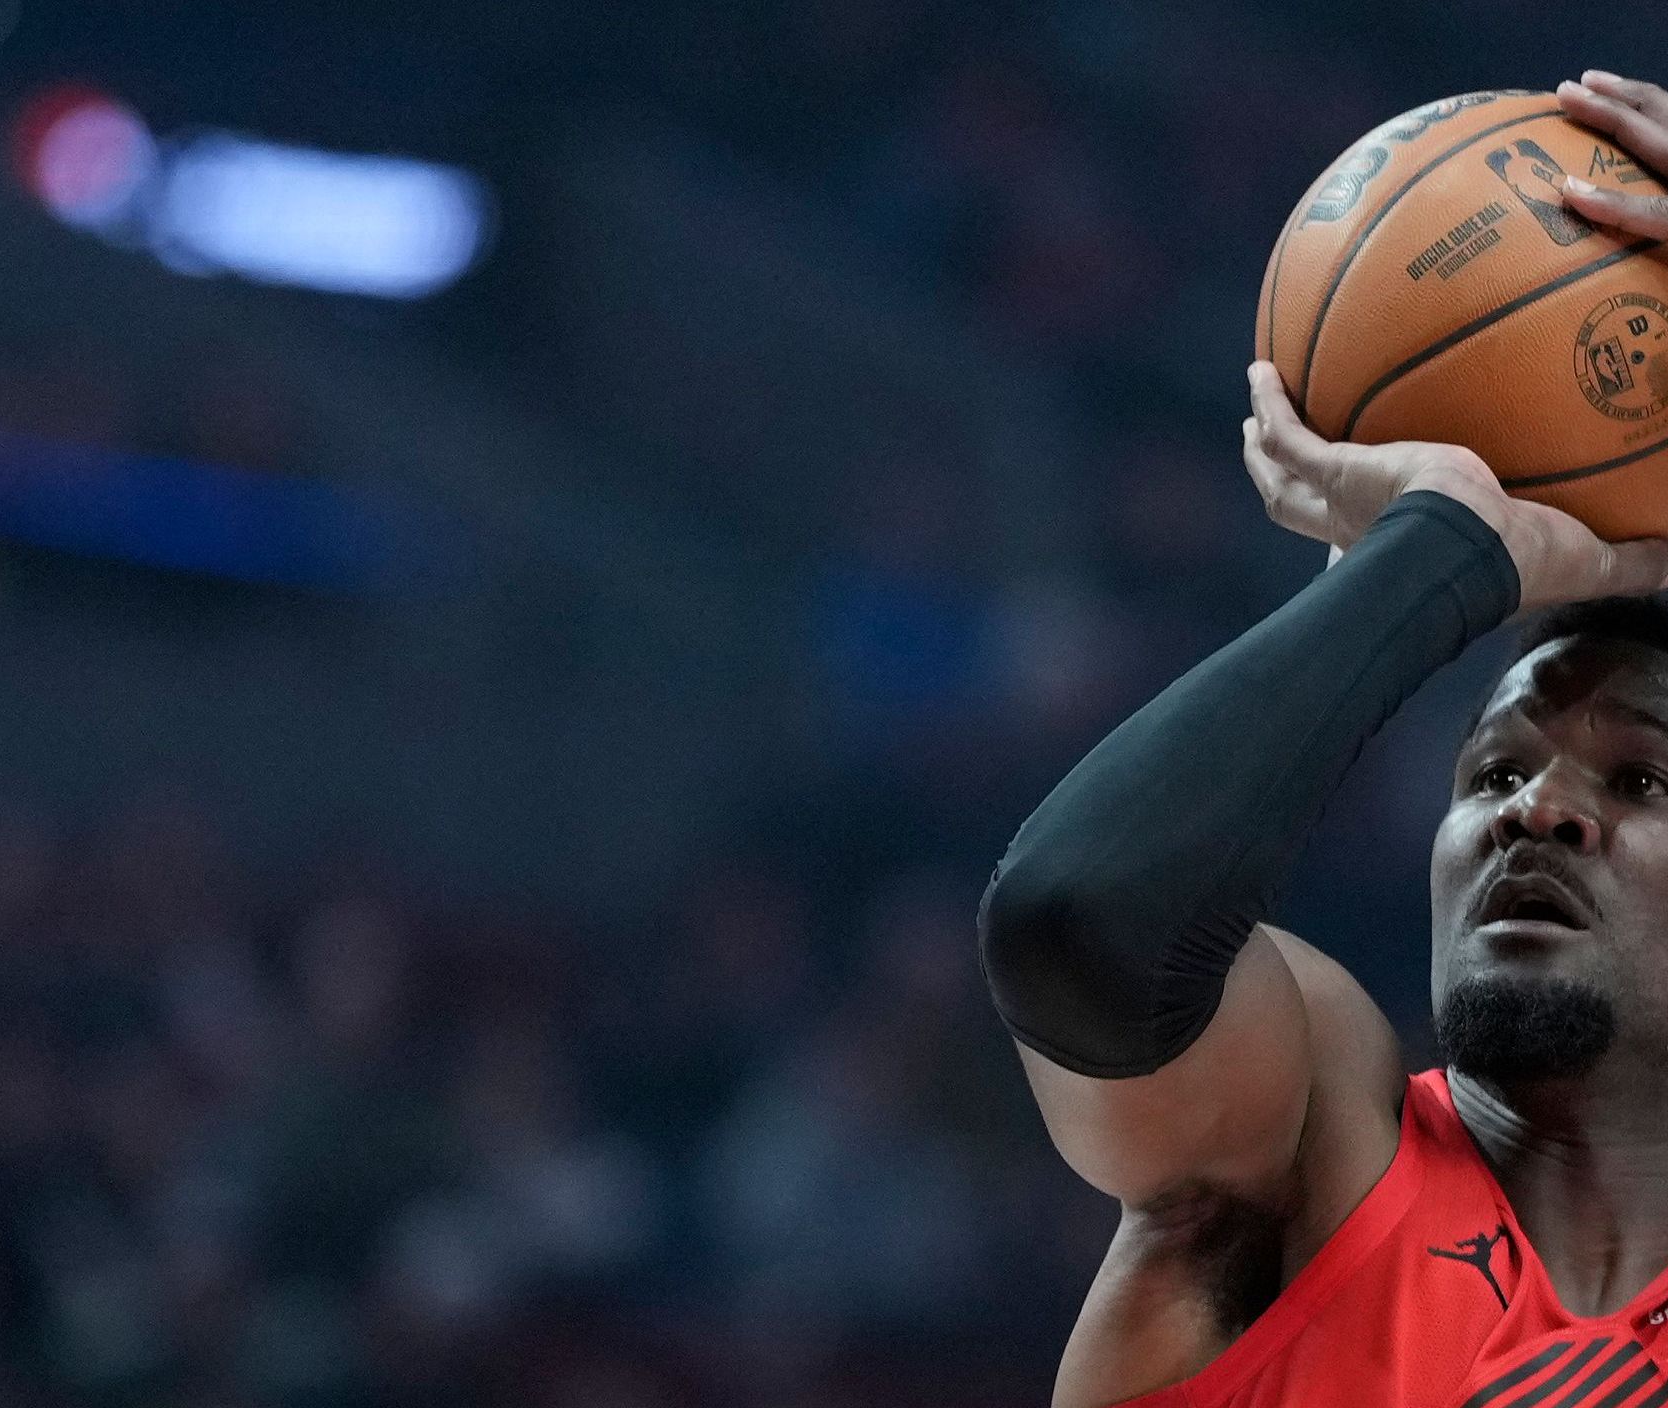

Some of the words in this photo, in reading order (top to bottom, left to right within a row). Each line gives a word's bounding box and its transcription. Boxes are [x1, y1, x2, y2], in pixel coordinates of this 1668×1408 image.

[1406, 238, 1454, 281] OFFICIAL
[1447, 216, 1483, 247] GAME
[1476, 201, 1509, 227] BALL
